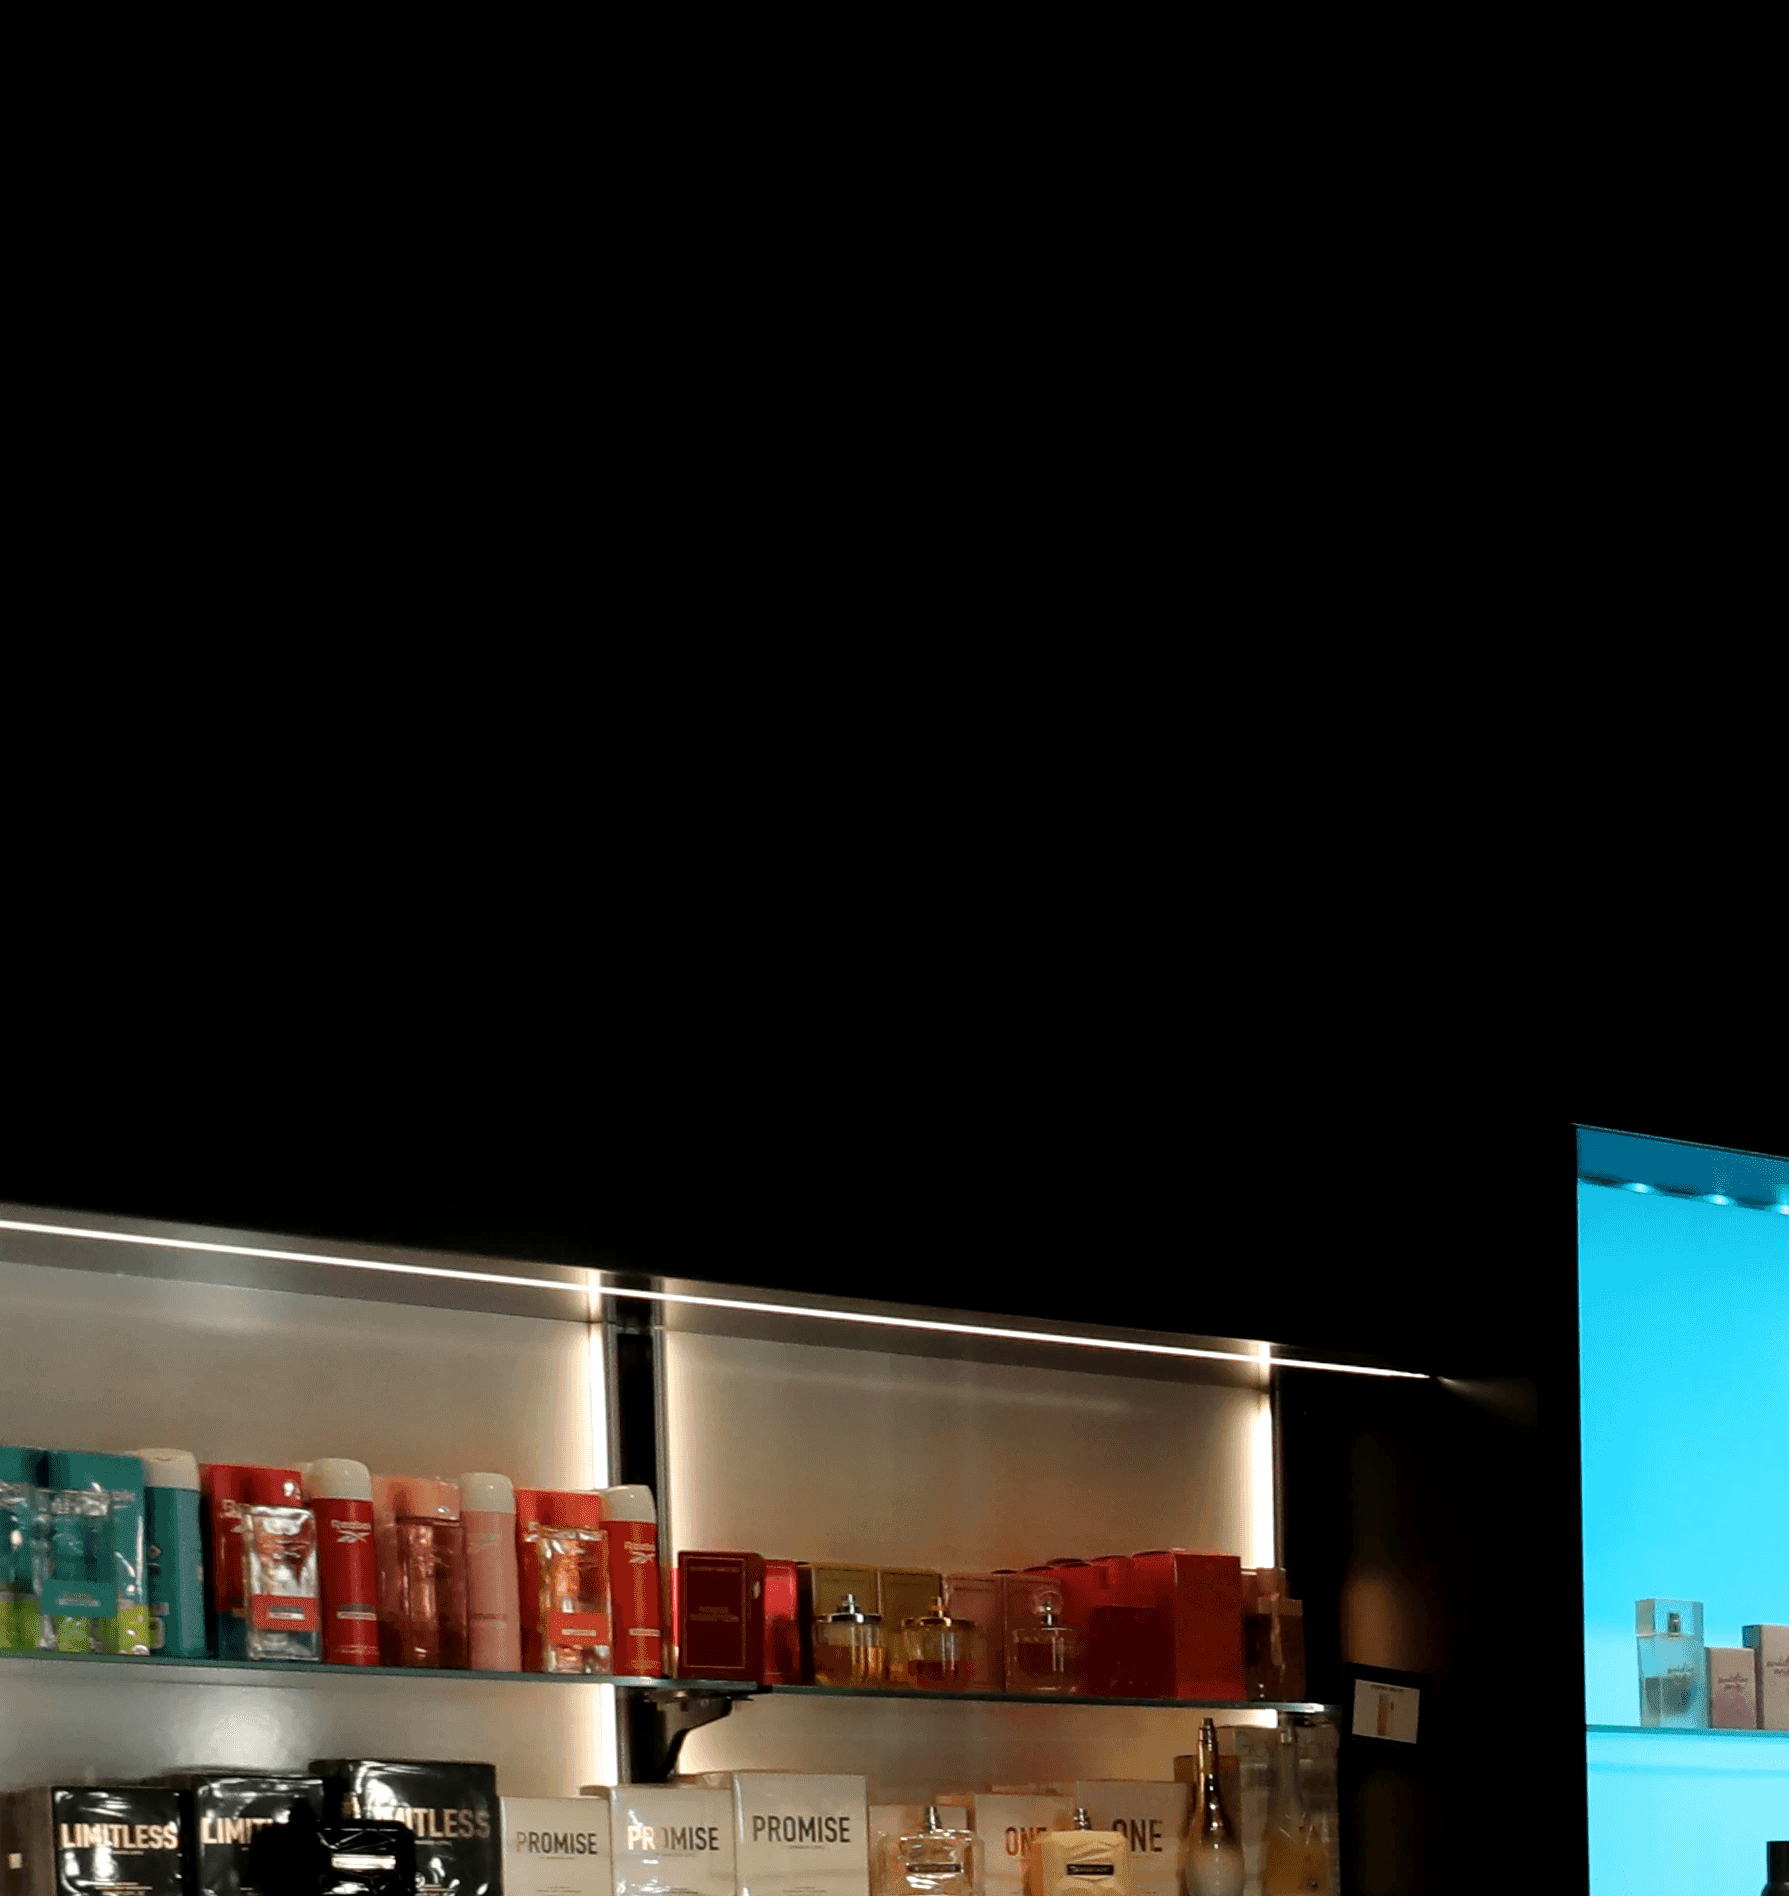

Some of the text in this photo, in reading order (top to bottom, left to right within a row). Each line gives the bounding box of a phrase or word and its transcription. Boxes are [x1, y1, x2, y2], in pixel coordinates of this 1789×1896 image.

[60, 1822, 179, 1850] LIMITLESS
[516, 1831, 598, 1856] PROMISE
[628, 1825, 719, 1852] PROMISE
[753, 1815, 850, 1844] PROMISE
[1005, 1826, 1047, 1857] ON
